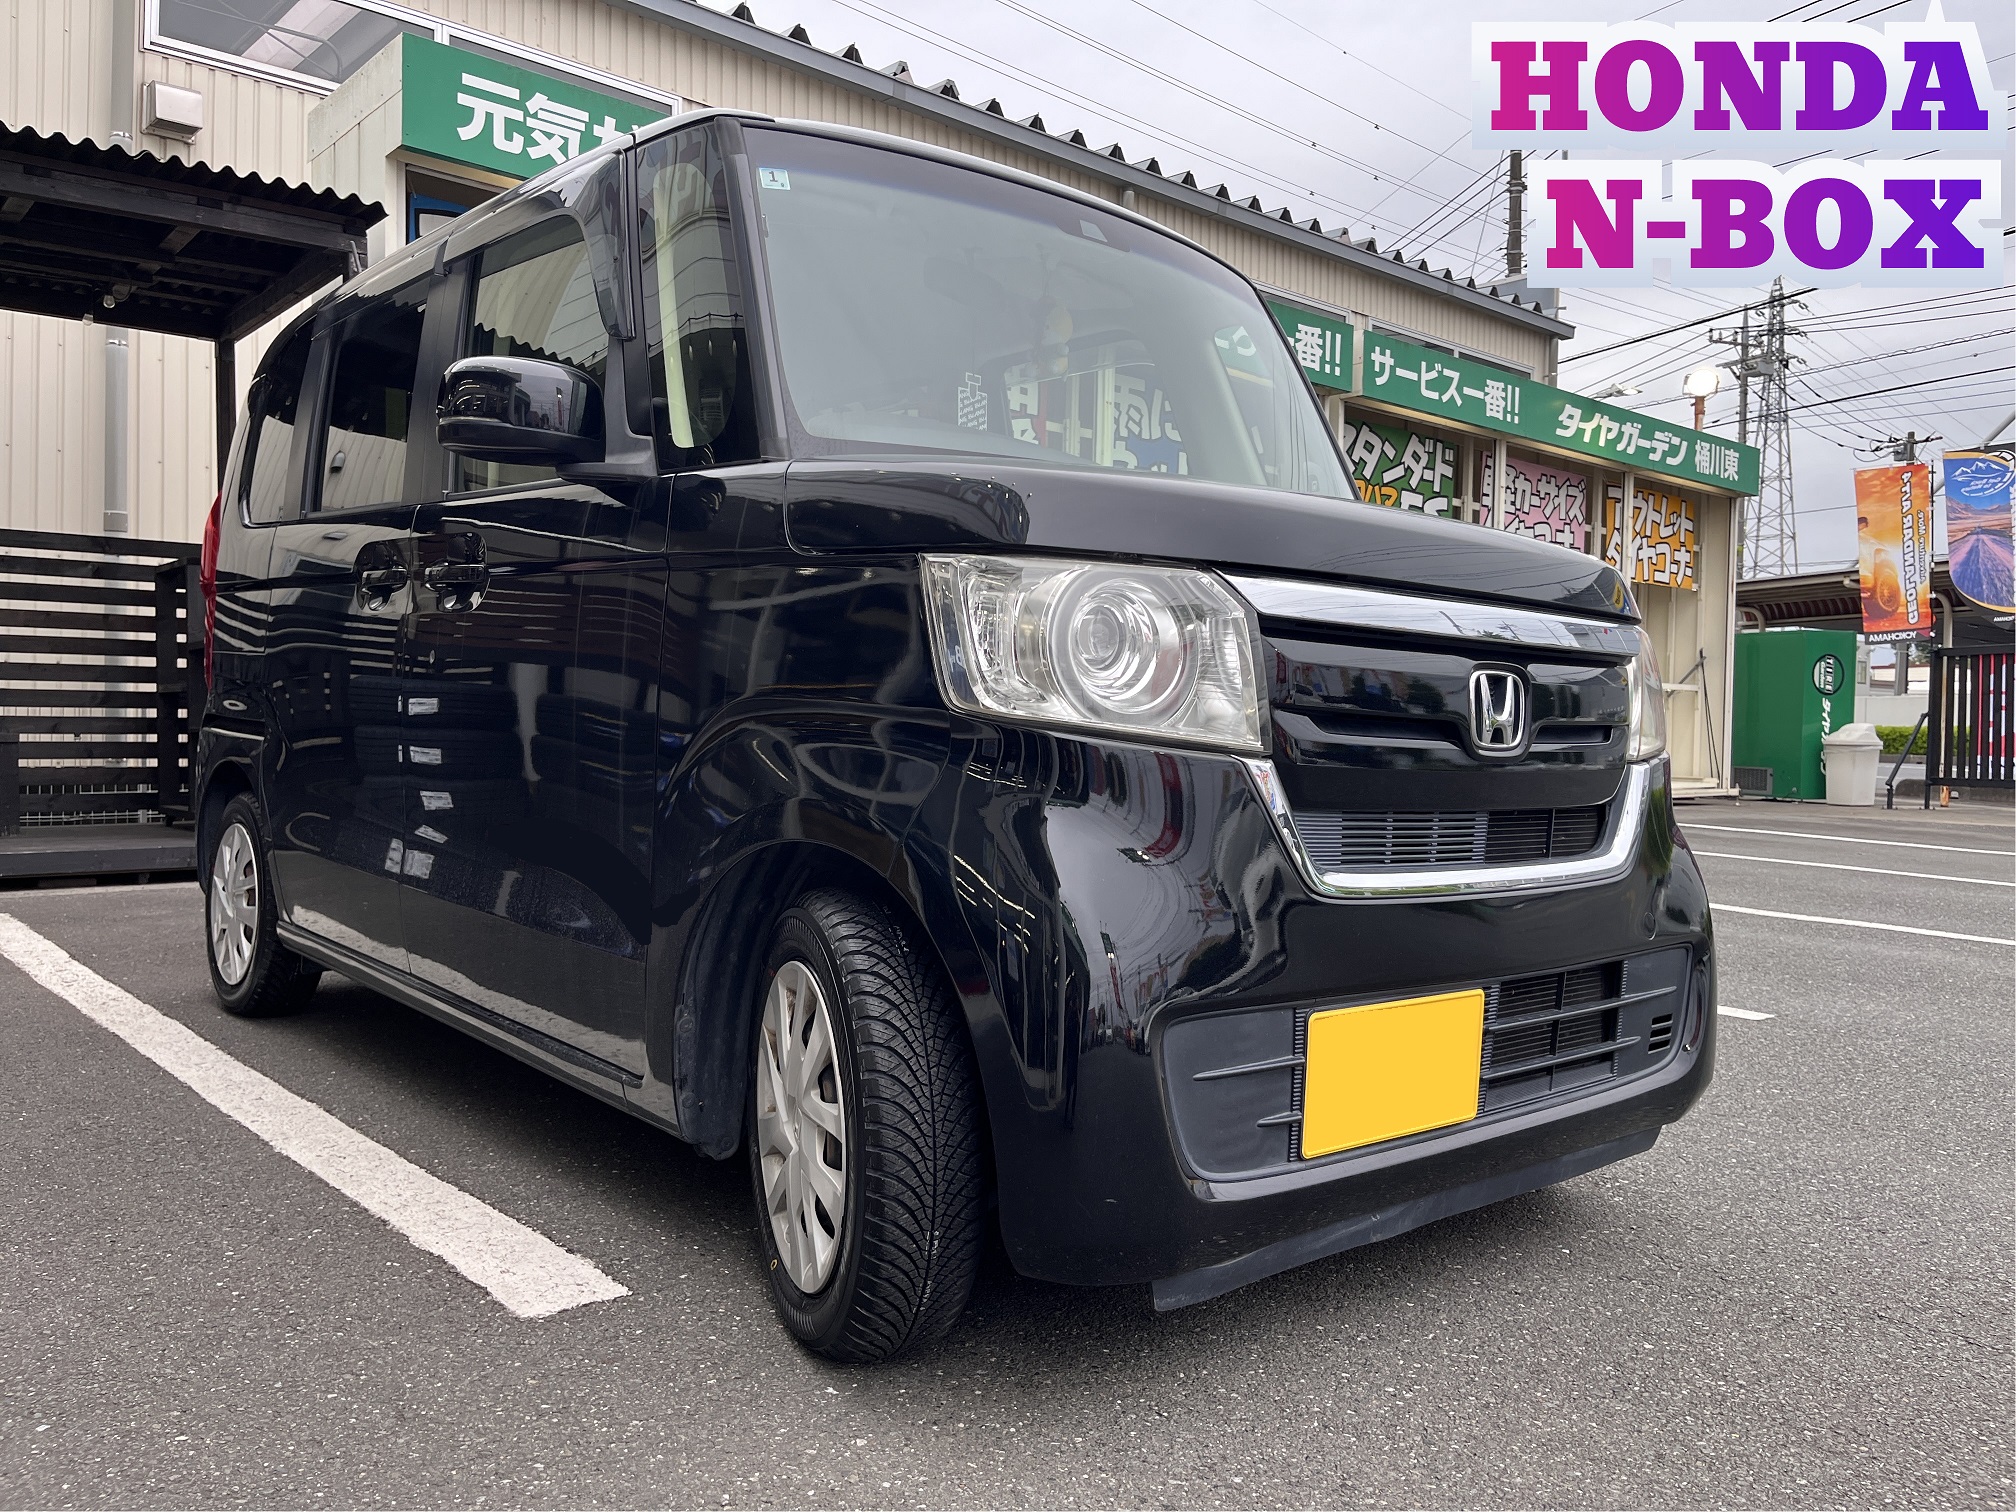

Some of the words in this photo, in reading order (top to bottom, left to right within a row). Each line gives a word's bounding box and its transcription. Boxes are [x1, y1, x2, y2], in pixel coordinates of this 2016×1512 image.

[1556, 403, 1688, 466] タイヤガーデン
[1695, 440, 1740, 481] 桶川東
[1825, 657, 1834, 693] TIRE
